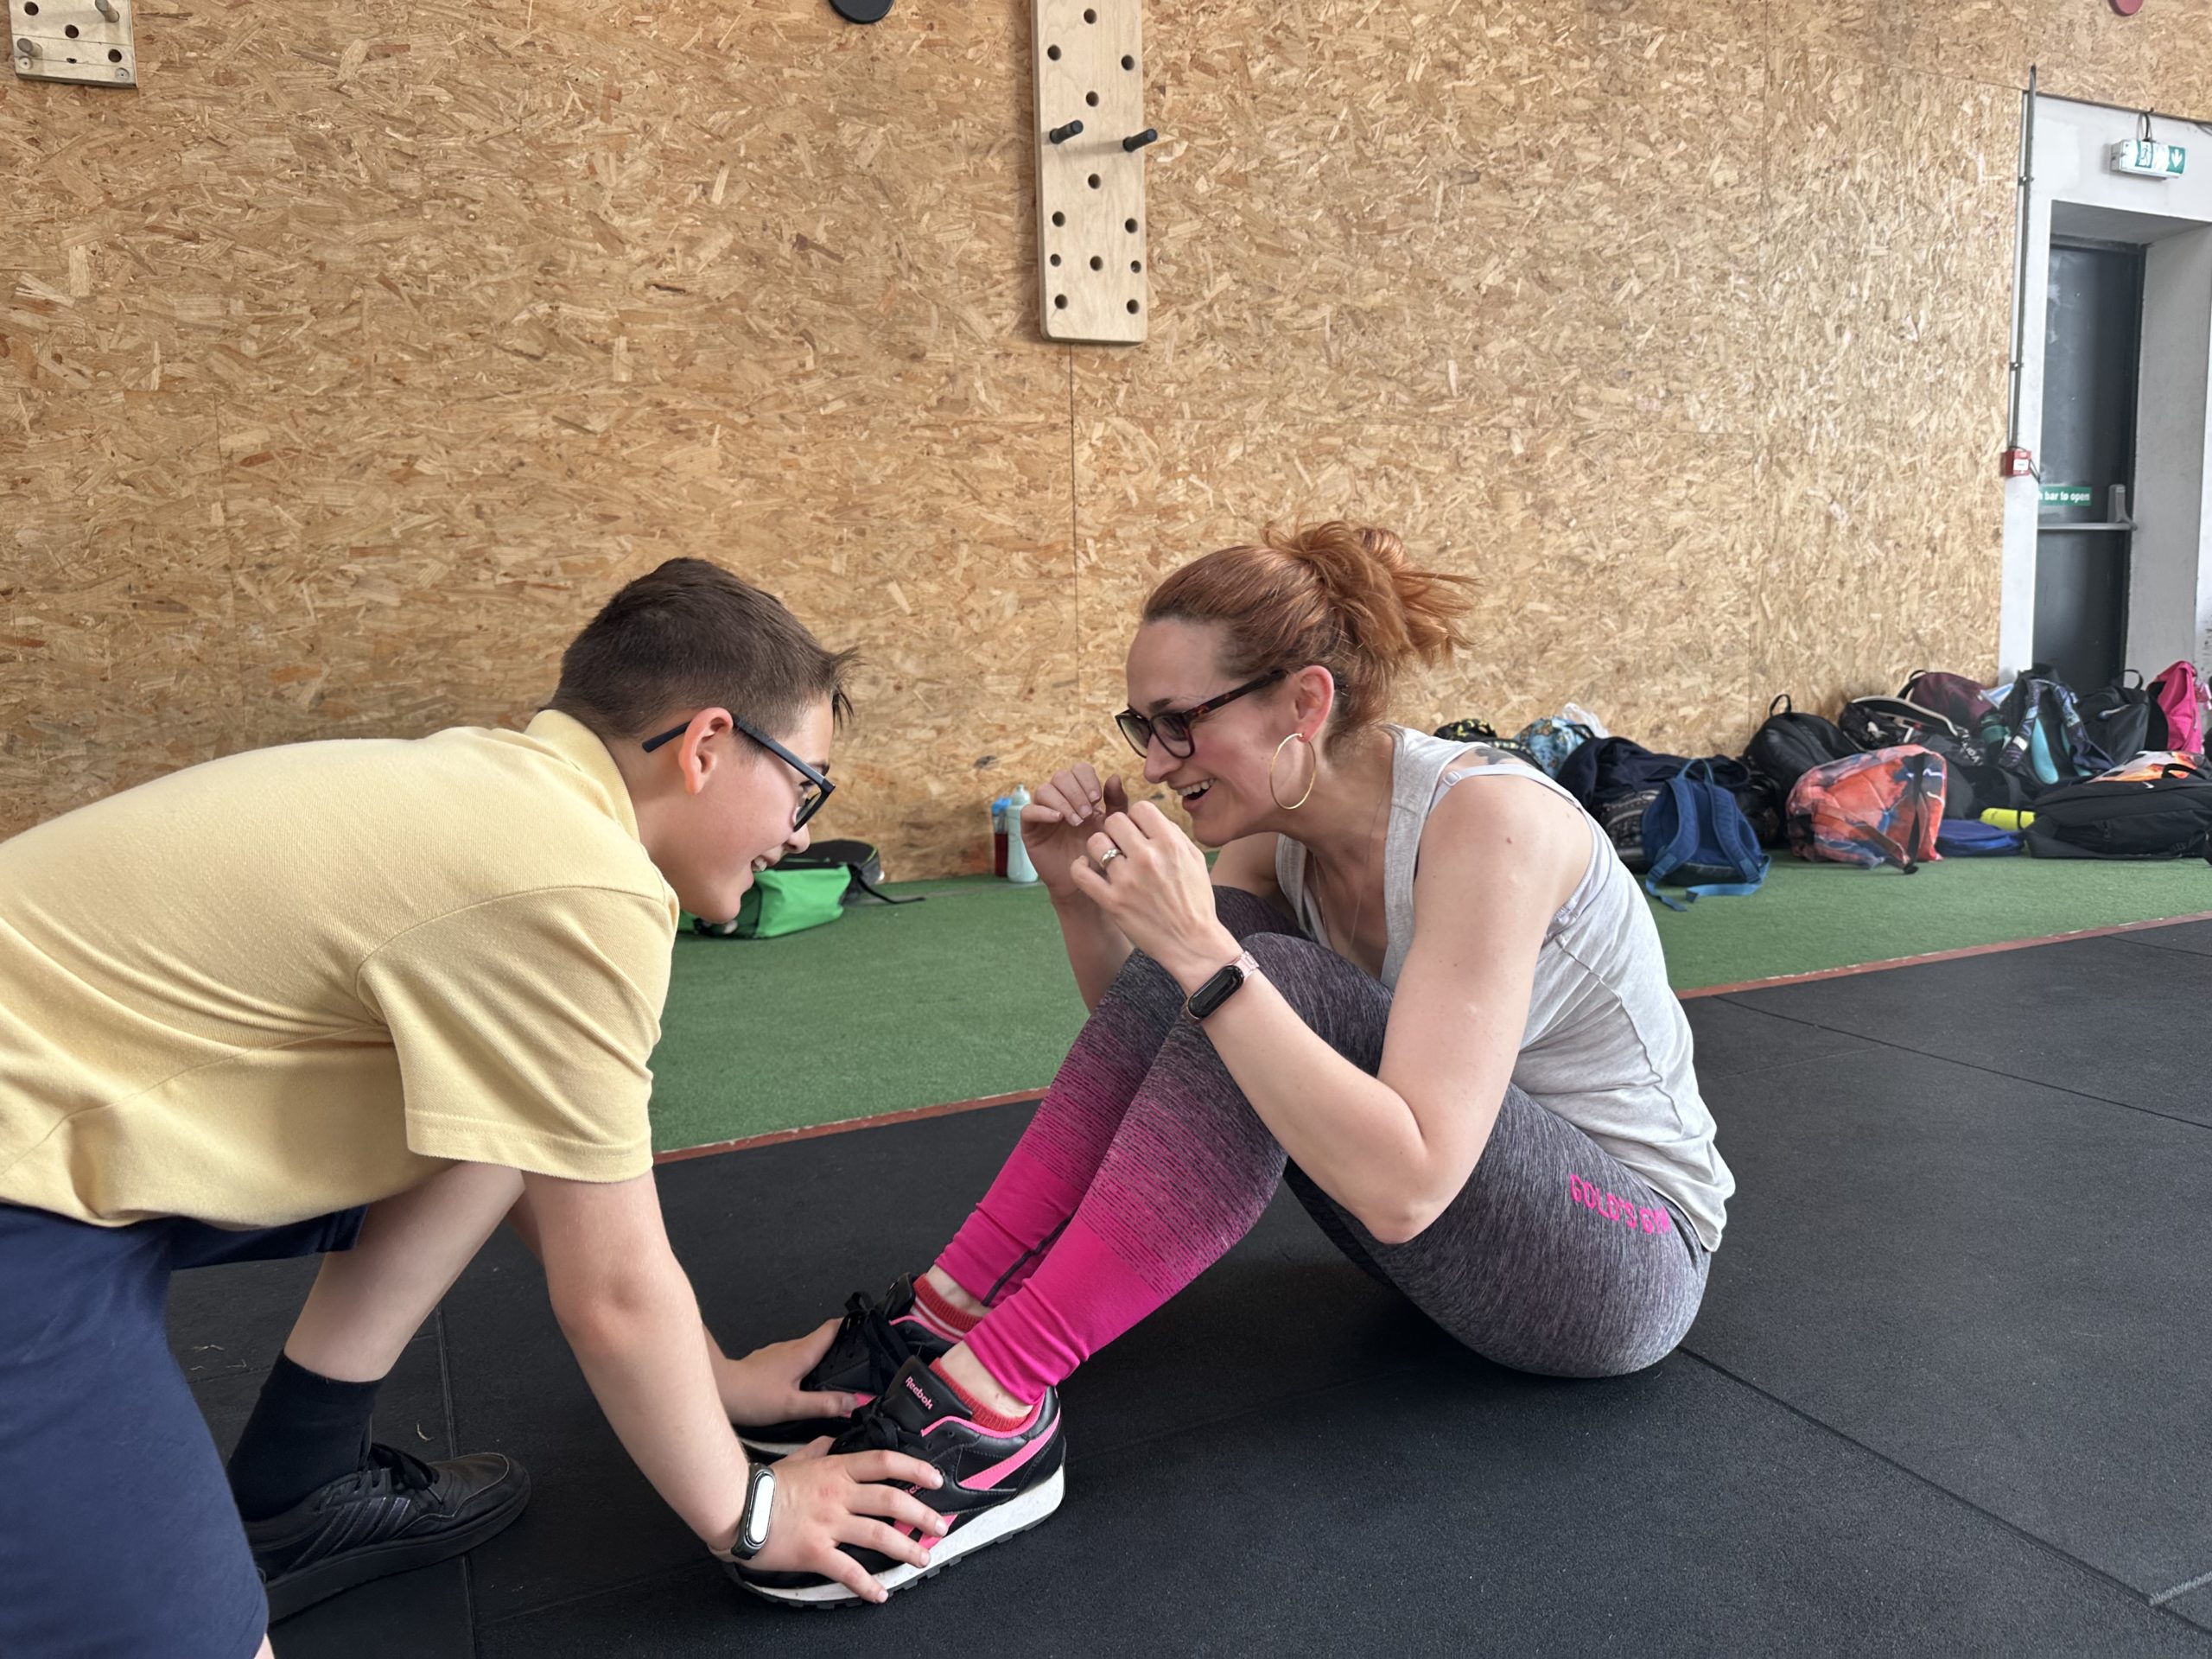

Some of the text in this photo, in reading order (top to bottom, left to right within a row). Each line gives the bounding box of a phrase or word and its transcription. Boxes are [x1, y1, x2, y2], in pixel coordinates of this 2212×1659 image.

[2044, 491, 2059, 501] bar
[2060, 491, 2069, 501] to
[2070, 493, 2090, 504] open
[1570, 1173, 1637, 1229] GOLD'S
[905, 1376, 933, 1410] Reebok
